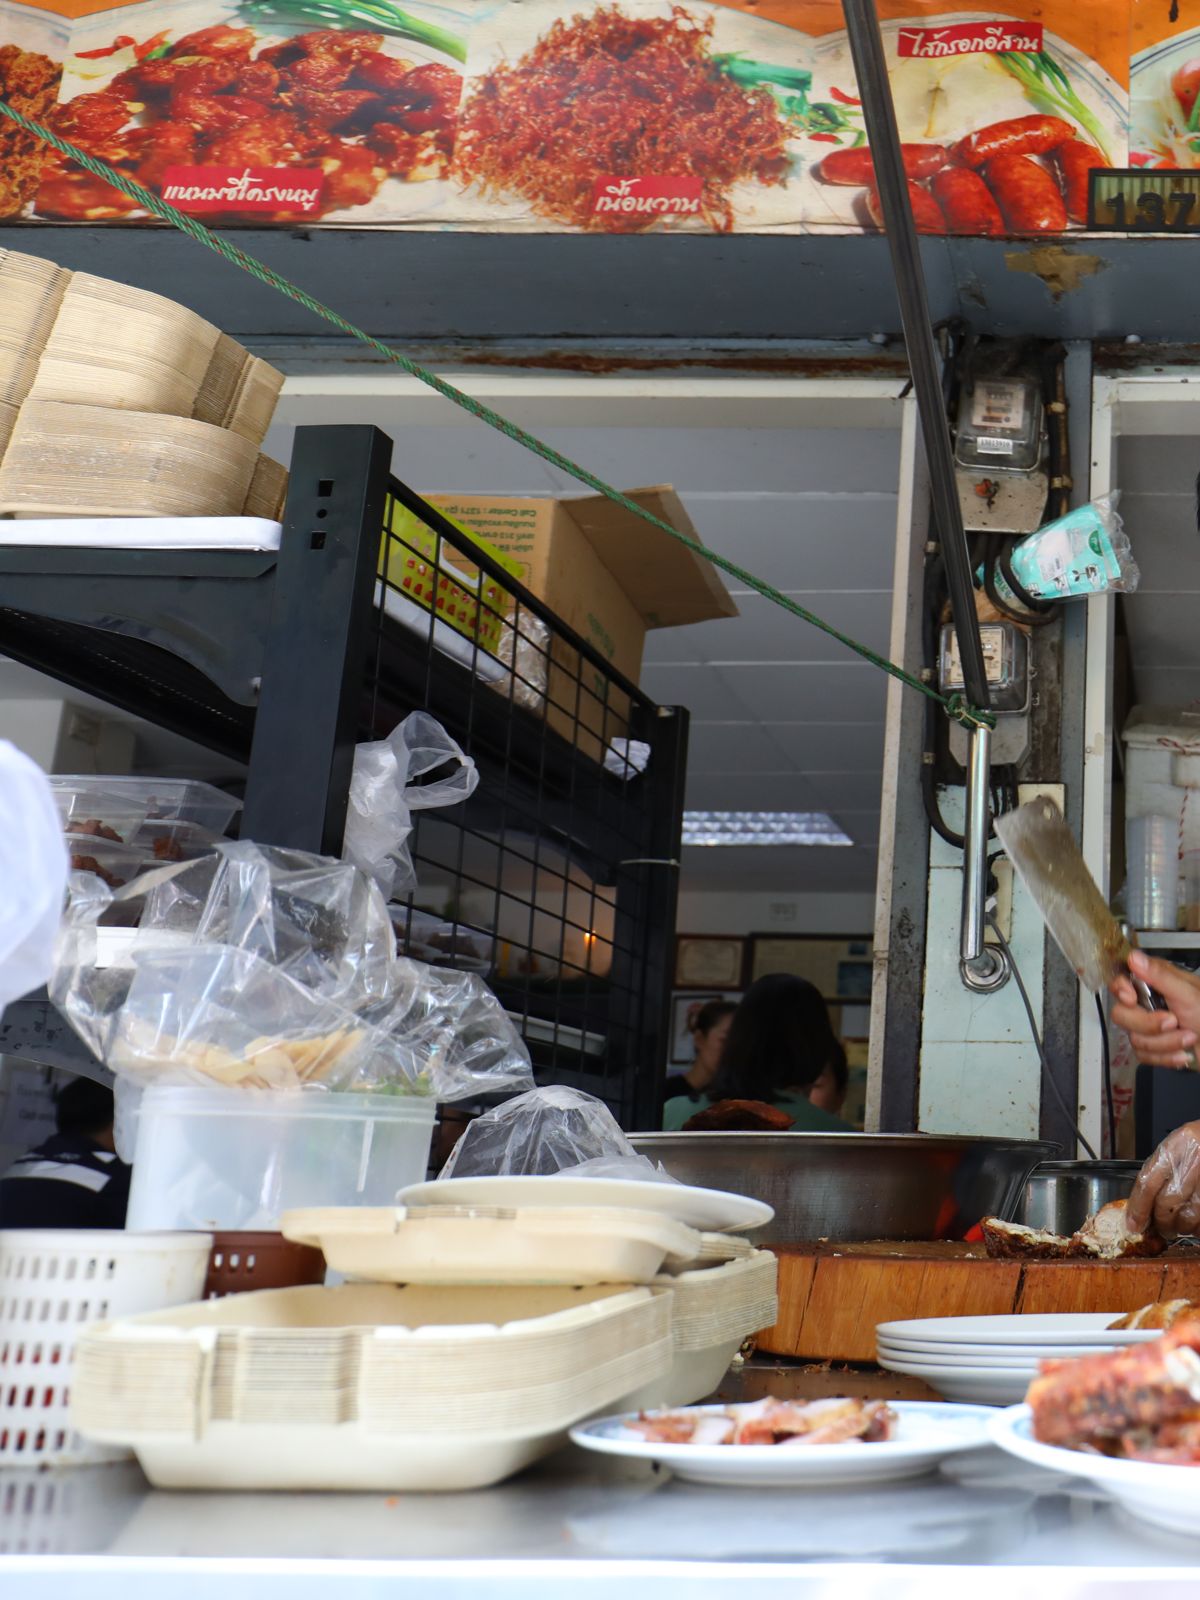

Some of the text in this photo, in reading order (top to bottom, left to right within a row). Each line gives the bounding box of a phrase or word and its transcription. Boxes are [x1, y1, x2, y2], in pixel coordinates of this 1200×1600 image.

[899, 26, 1039, 56] ไส้กรอกอีสาน
[163, 168, 319, 211] แหนมซี่โครงหมู
[595, 178, 700, 213] เนื้อหวาน
